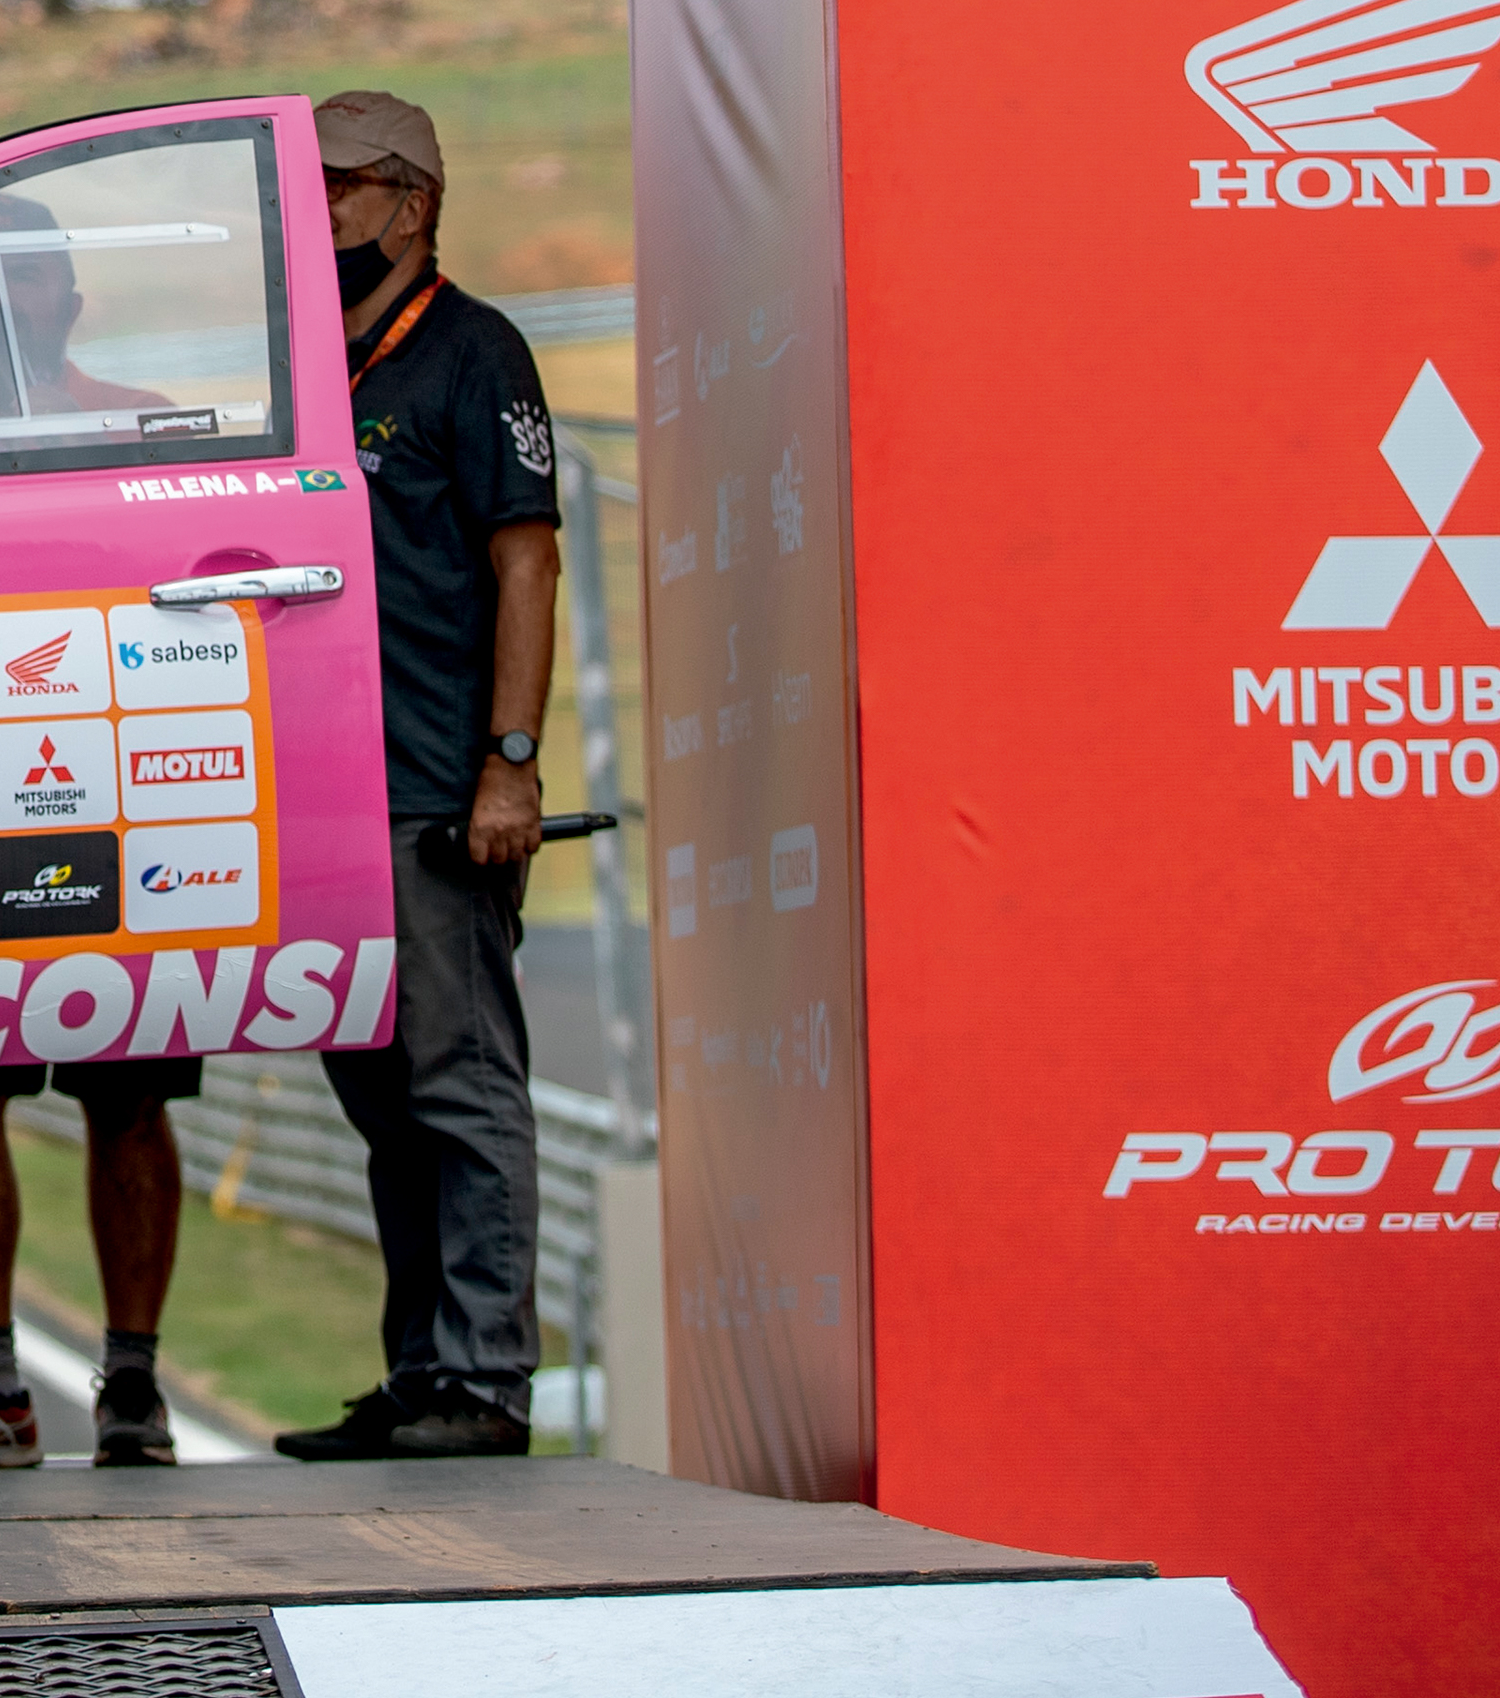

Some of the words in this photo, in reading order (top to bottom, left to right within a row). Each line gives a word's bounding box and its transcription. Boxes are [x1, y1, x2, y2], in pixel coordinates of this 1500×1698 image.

[1189, 157, 1500, 209] HOND
[119, 474, 249, 502] HELENA
[151, 640, 238, 664] sabesp
[7, 682, 80, 696] HONDA
[136, 749, 241, 782] MOTUL
[1292, 738, 1500, 799] MOTO
[14, 788, 86, 804] MITSUBISHI
[24, 803, 77, 817] MOTORS
[183, 868, 242, 886] ALE
[1, 889, 46, 905] PRO
[48, 884, 103, 900] TORK
[1103, 1130, 1396, 1199] PRO
[1414, 1128, 1500, 1195] T
[1195, 1213, 1367, 1234] RACING
